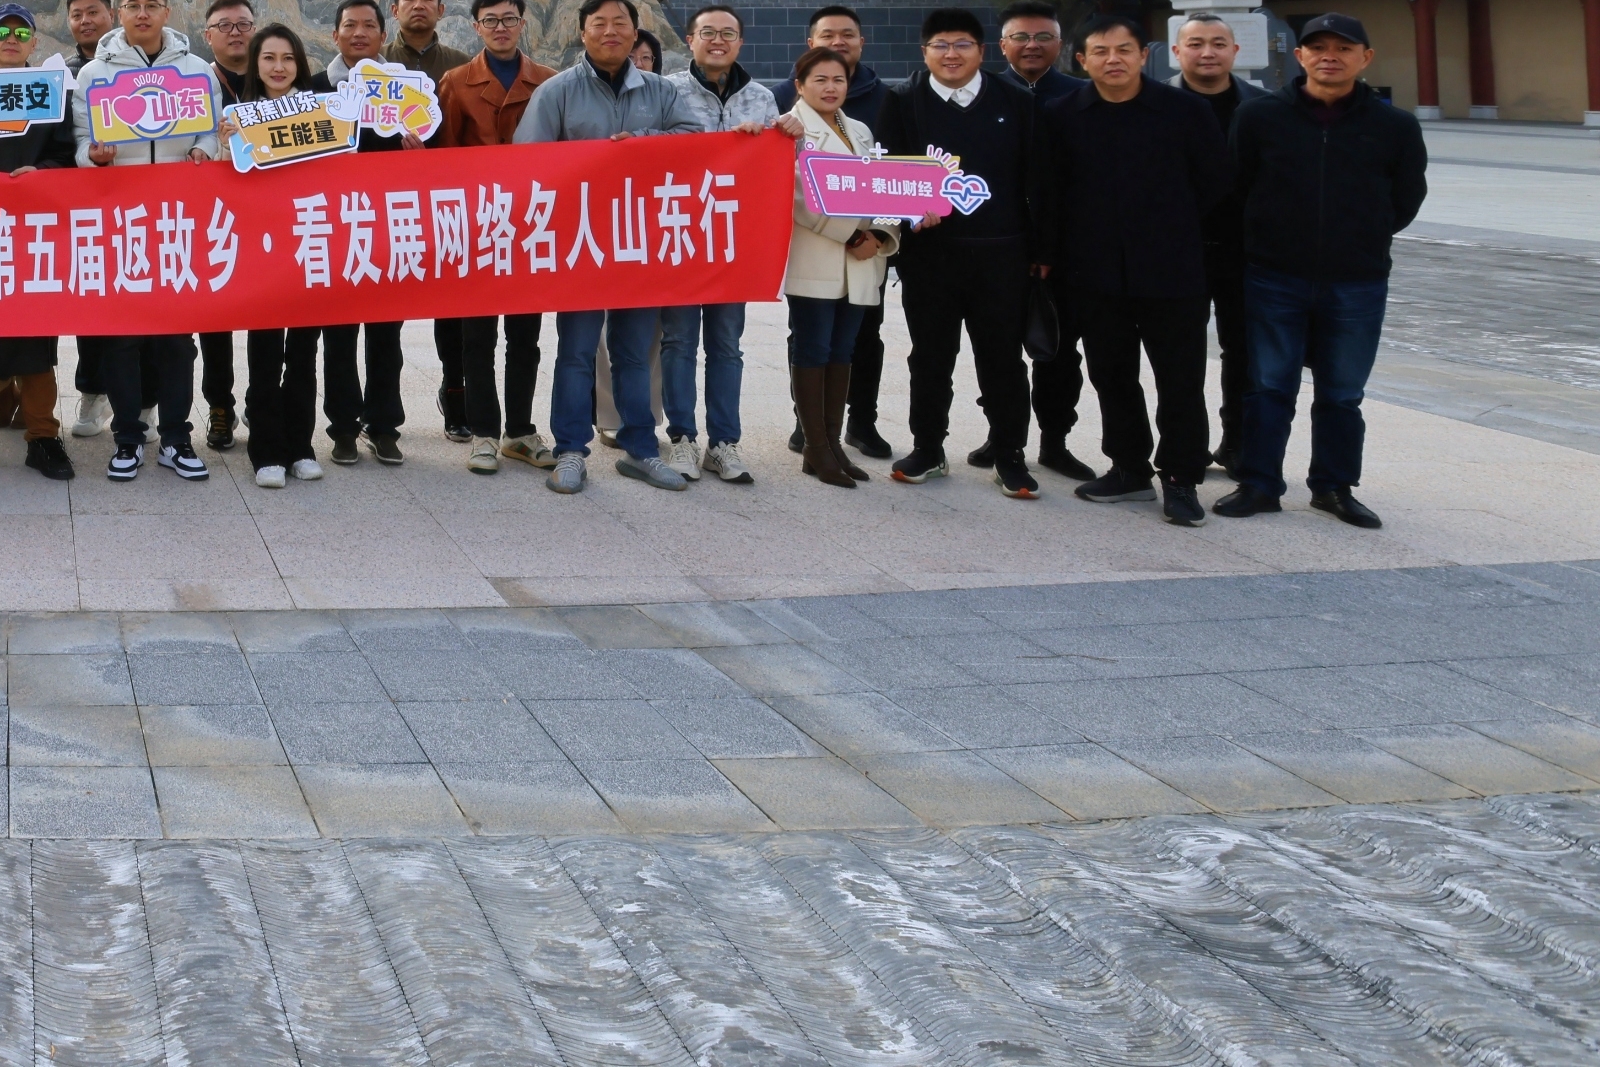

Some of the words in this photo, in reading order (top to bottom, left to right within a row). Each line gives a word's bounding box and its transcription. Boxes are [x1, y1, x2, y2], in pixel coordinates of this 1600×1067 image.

[0, 82, 50, 111] 泰安
[365, 79, 404, 100] 文化
[151, 88, 208, 121] 山东
[235, 90, 320, 127] 聚焦山东
[361, 104, 398, 124] 山东
[268, 119, 337, 149] 正能量
